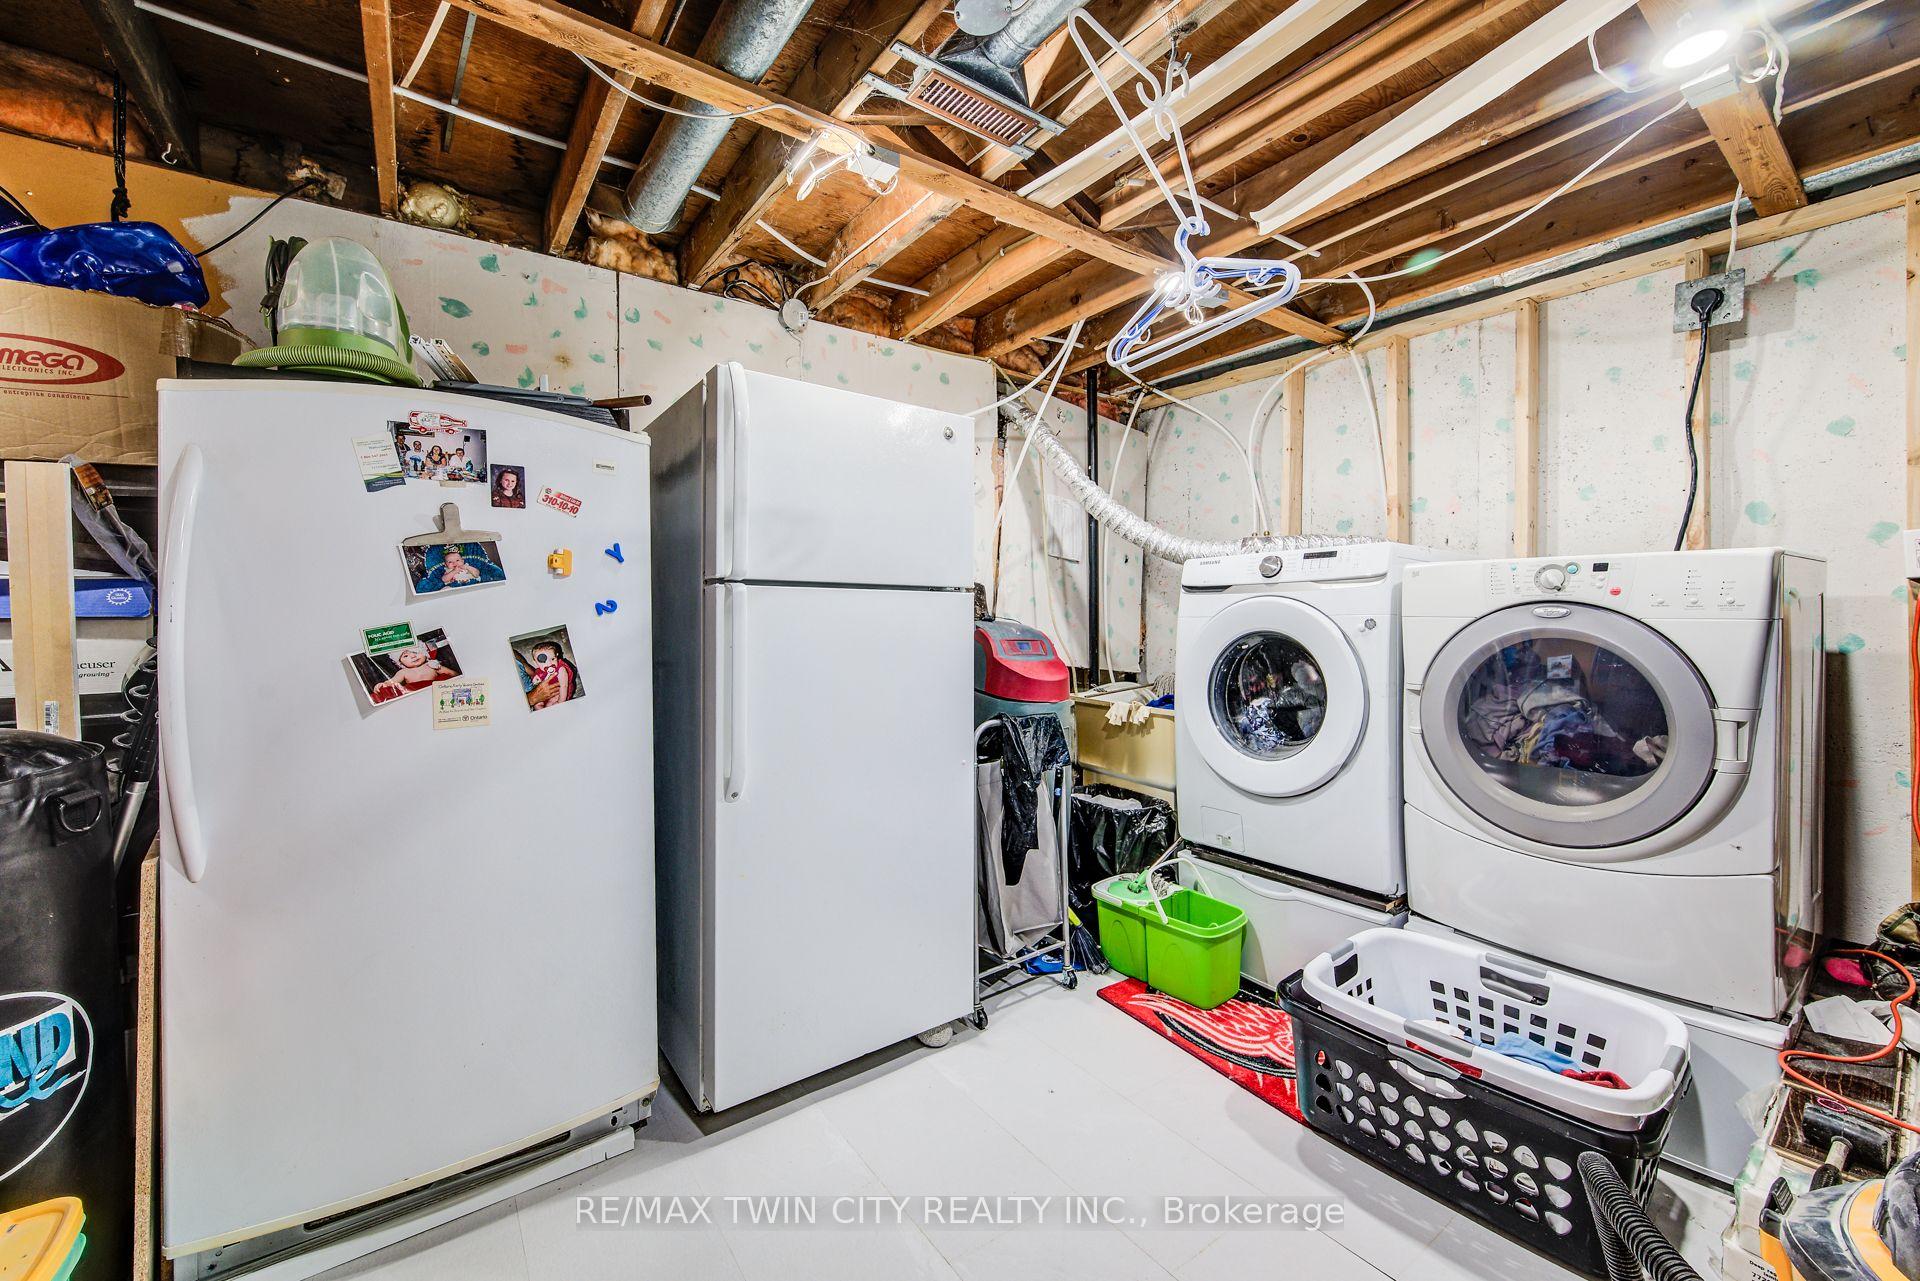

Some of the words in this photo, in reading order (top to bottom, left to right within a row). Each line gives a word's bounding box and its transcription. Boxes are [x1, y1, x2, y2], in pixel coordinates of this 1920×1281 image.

[58, 369, 76, 377] INC.
[541, 494, 579, 515] 310-10-10
[605, 543, 625, 563] Y
[78, 671, 110, 679] growing
